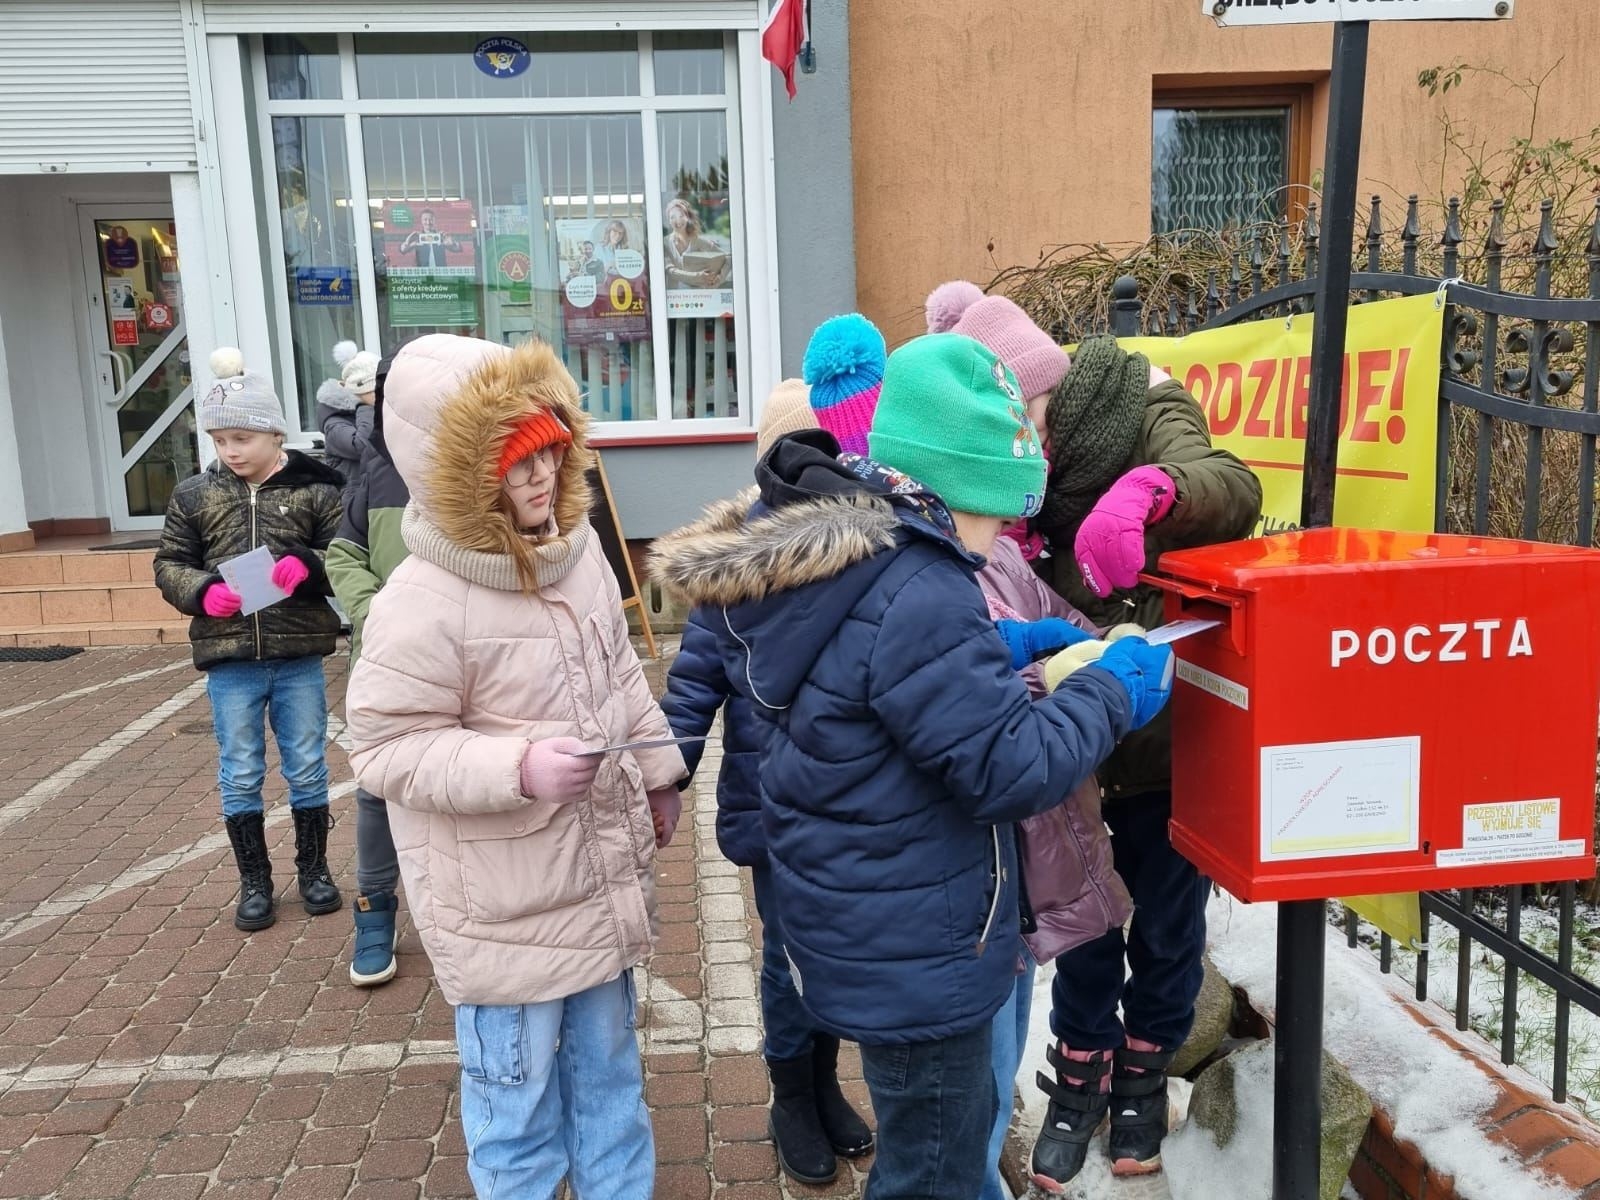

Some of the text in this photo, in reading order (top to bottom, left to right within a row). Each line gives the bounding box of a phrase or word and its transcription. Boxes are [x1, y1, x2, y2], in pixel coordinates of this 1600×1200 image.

[396, 285, 417, 293] oferty
[418, 285, 448, 293] kredytów
[1163, 348, 1412, 444] ODZIEJE!
[853, 460, 868, 473] TOP
[860, 461, 879, 480] PUPS
[1330, 617, 1534, 668] POCZTA
[1467, 801, 1557, 821] PRZESYŁKI LISTOWE
[1482, 815, 1543, 832] WYJMUJE SIĘ
